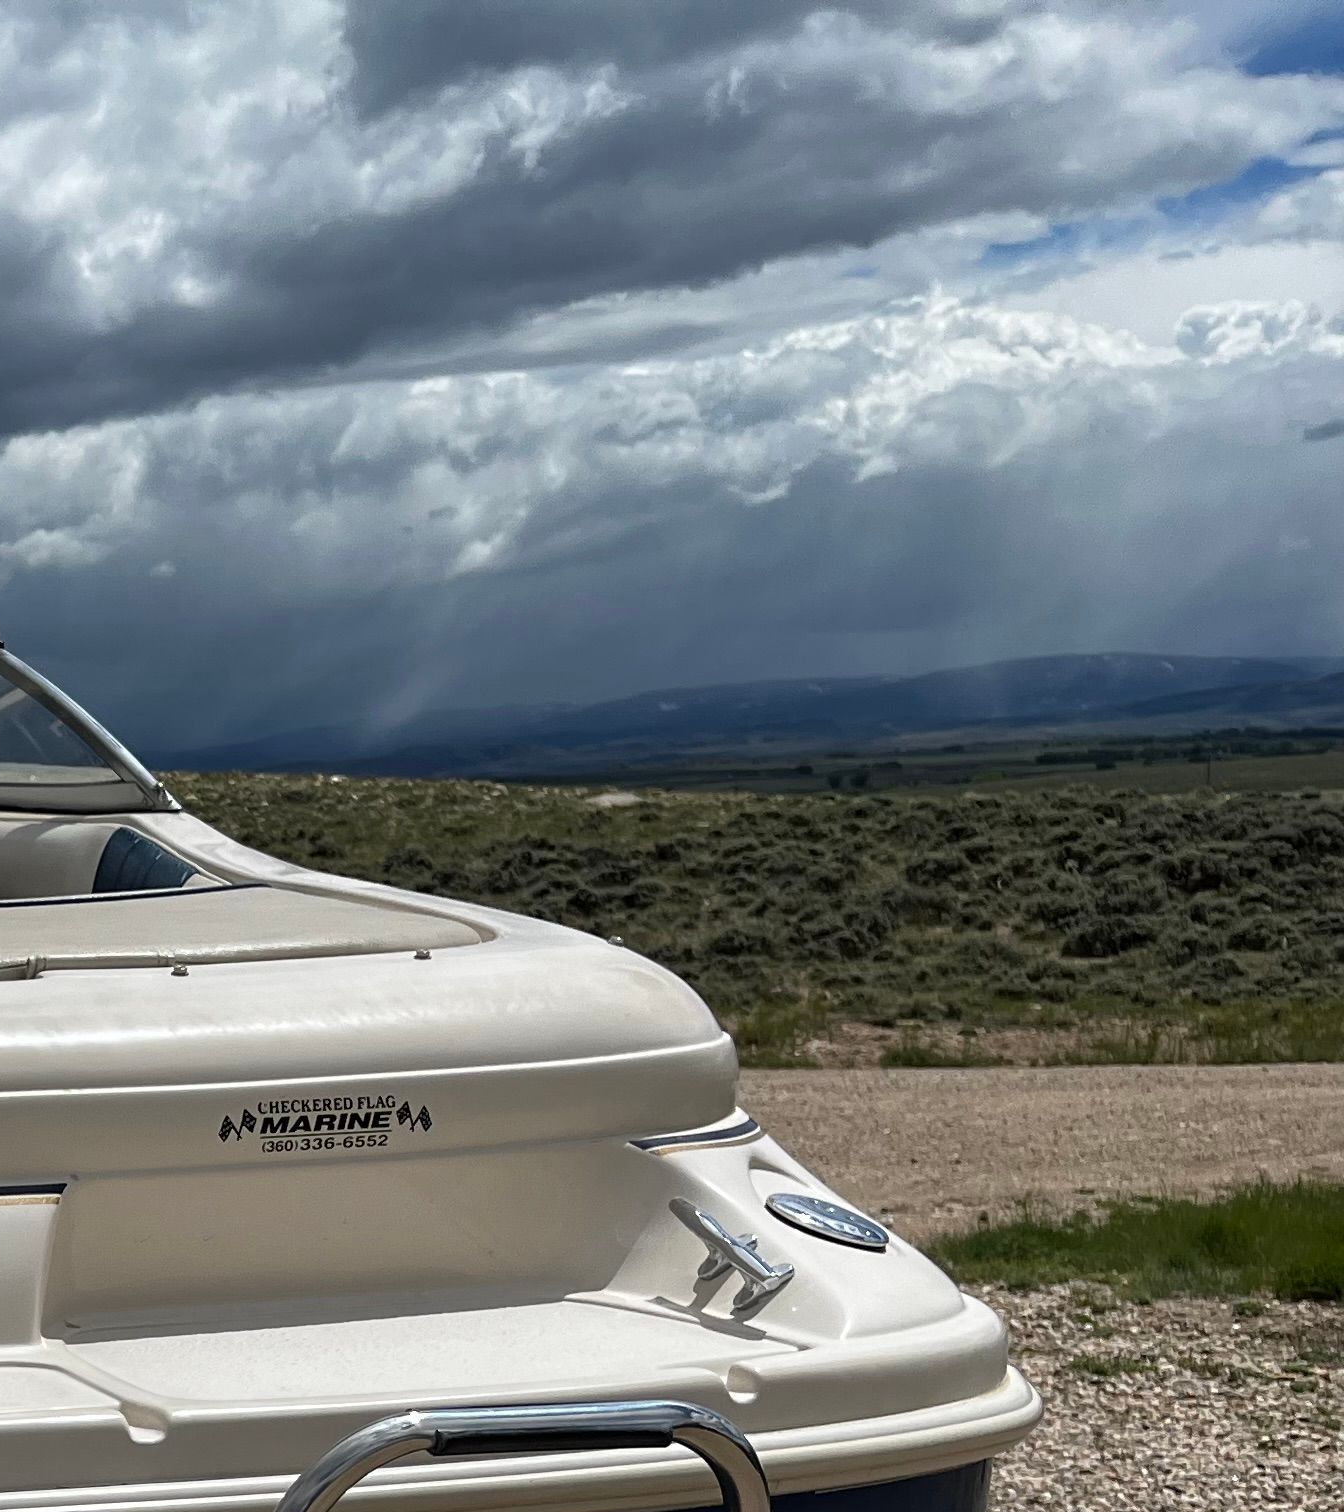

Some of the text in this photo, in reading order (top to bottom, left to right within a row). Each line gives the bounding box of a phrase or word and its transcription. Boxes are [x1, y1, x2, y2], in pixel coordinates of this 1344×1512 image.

[257, 1095, 397, 1115] CHECKERED FLAG
[260, 1110, 393, 1135] MARINE
